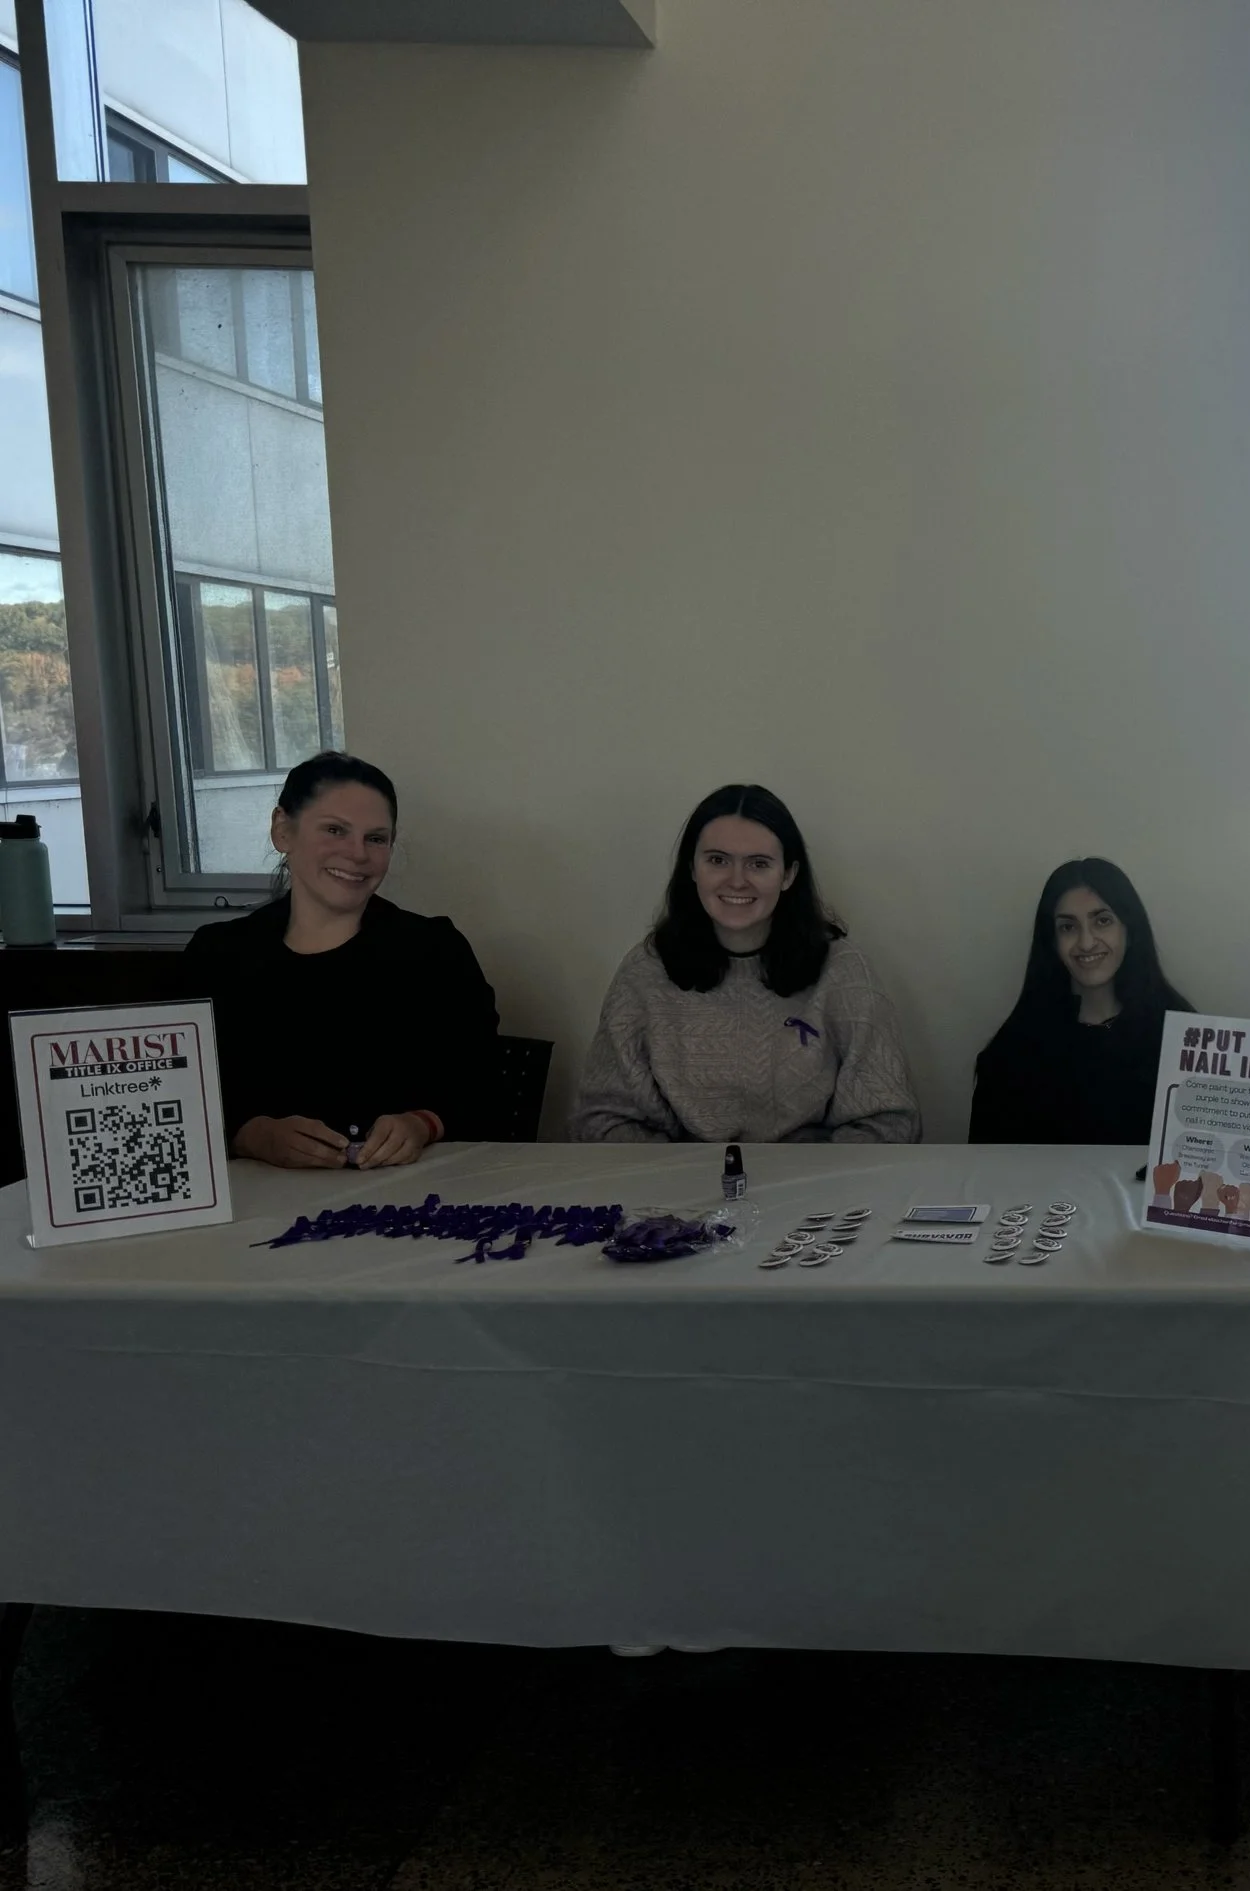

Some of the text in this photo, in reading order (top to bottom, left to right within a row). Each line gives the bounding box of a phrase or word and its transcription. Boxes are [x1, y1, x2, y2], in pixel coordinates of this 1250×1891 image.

[1183, 1027, 1246, 1053] #PUT
[49, 1032, 186, 1067] MARIST
[65, 1059, 174, 1078] TITLE IX OFFICE
[1179, 1049, 1231, 1077] NAIL
[1185, 1080, 1207, 1090] Come
[1209, 1083, 1228, 1092] paint
[1229, 1087, 1246, 1096] your
[1195, 1094, 1219, 1104] purple
[1220, 1097, 1229, 1105] to
[1230, 1098, 1250, 1107] show
[1182, 1104, 1228, 1116] commitment
[1229, 1109, 1238, 1118] to
[1185, 1116, 1198, 1124] nail
[1206, 1119, 1241, 1130] domestic
[1186, 1136, 1213, 1146] Where:
